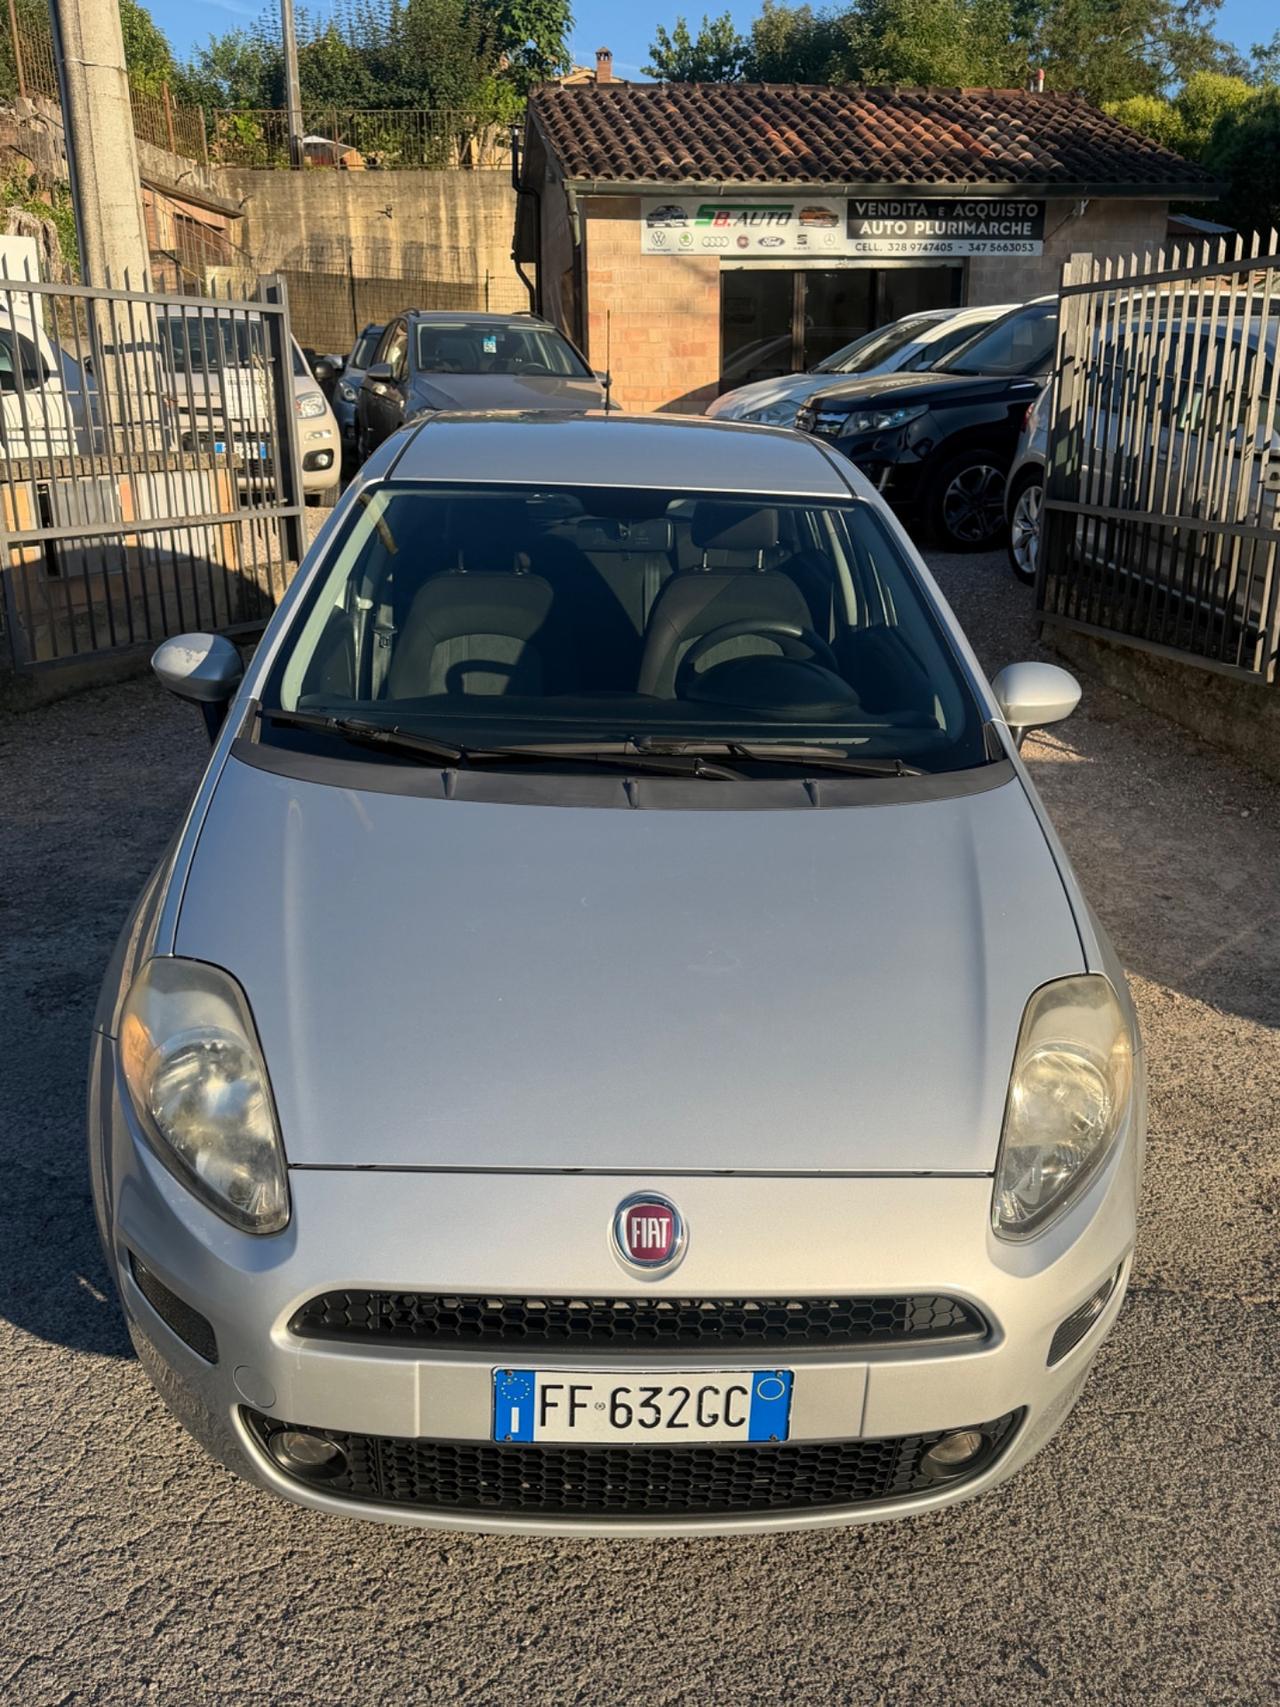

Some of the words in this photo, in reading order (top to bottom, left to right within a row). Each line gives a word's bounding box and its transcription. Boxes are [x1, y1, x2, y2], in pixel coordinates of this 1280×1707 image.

[855, 203, 928, 217] VENDITA
[953, 203, 1039, 219] ACQUISTO
[859, 221, 907, 235] AUTO
[914, 221, 1032, 235] PLURIMARCHE
[855, 243, 882, 252] CELL.
[888, 243, 907, 252] 328
[910, 243, 953, 252] 9747405
[968, 243, 986, 252] 347
[990, 243, 1034, 252] 5663053
[631, 1216, 670, 1249] FIAT
[539, 1384, 593, 1428] FF
[609, 1385, 750, 1429] 632GC
